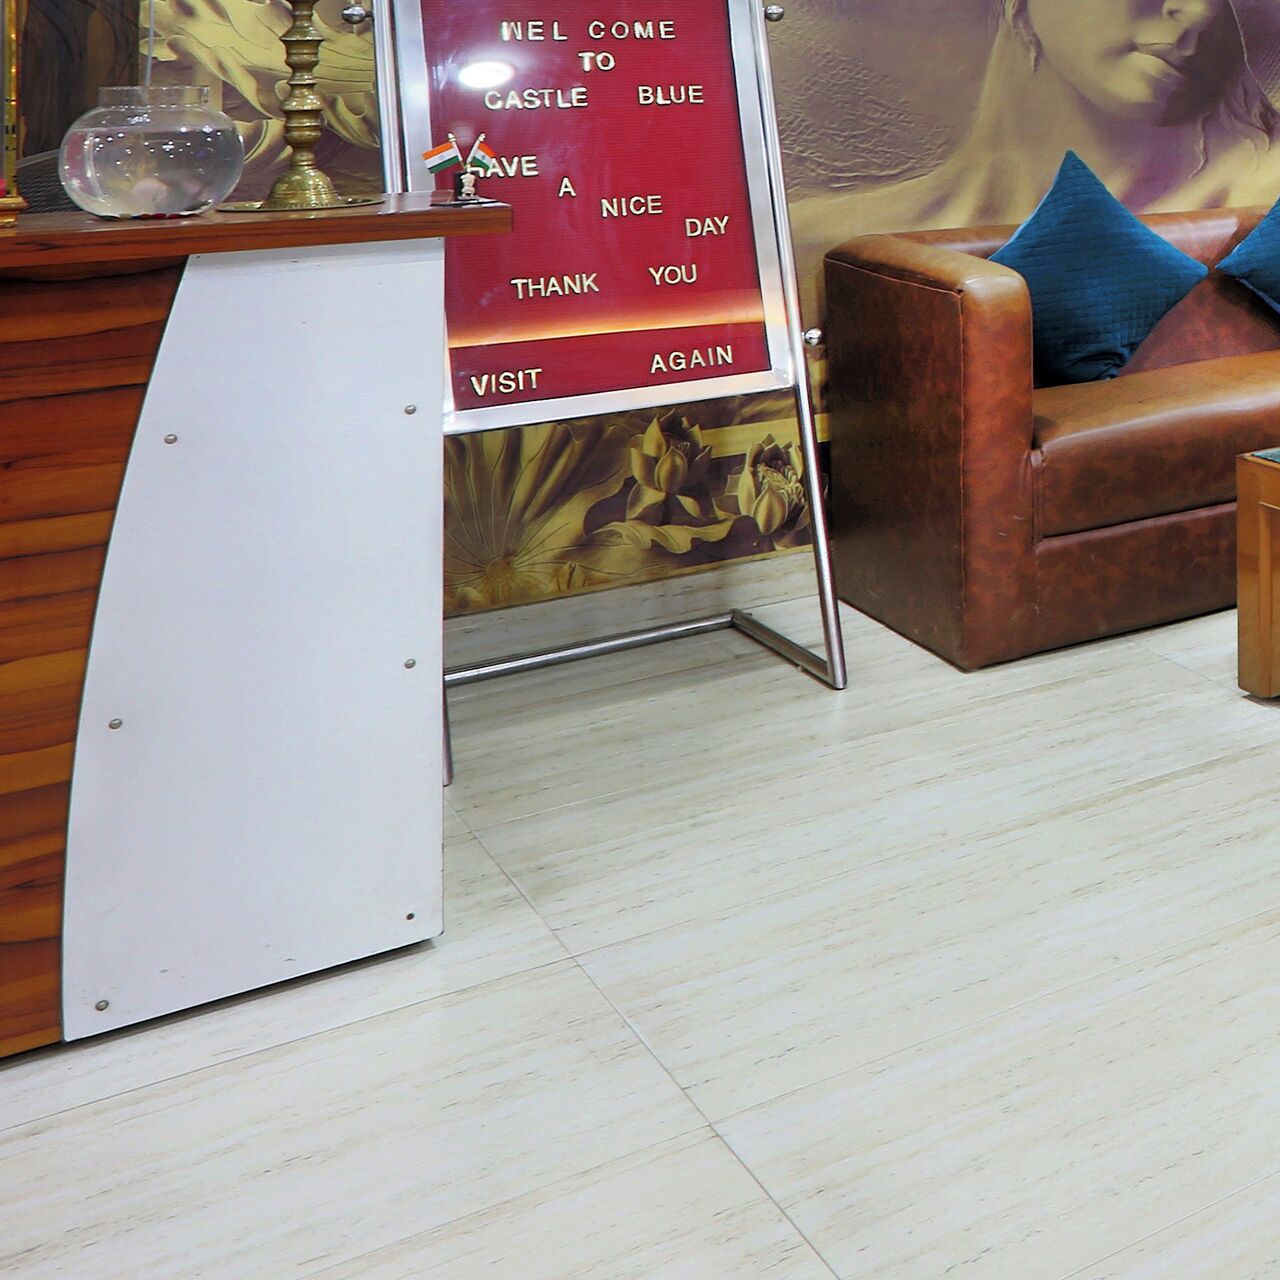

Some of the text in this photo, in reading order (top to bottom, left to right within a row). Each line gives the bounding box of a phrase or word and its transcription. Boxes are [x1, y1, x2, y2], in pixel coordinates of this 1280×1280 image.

[578, 51, 616, 73] TO
[484, 85, 704, 110] CASTLE BLUE
[558, 177, 577, 197] A
[601, 195, 662, 218] NICE
[685, 216, 730, 238] DAY
[510, 264, 698, 300] THANK YOU
[471, 345, 733, 397] VISIT AGAIN
